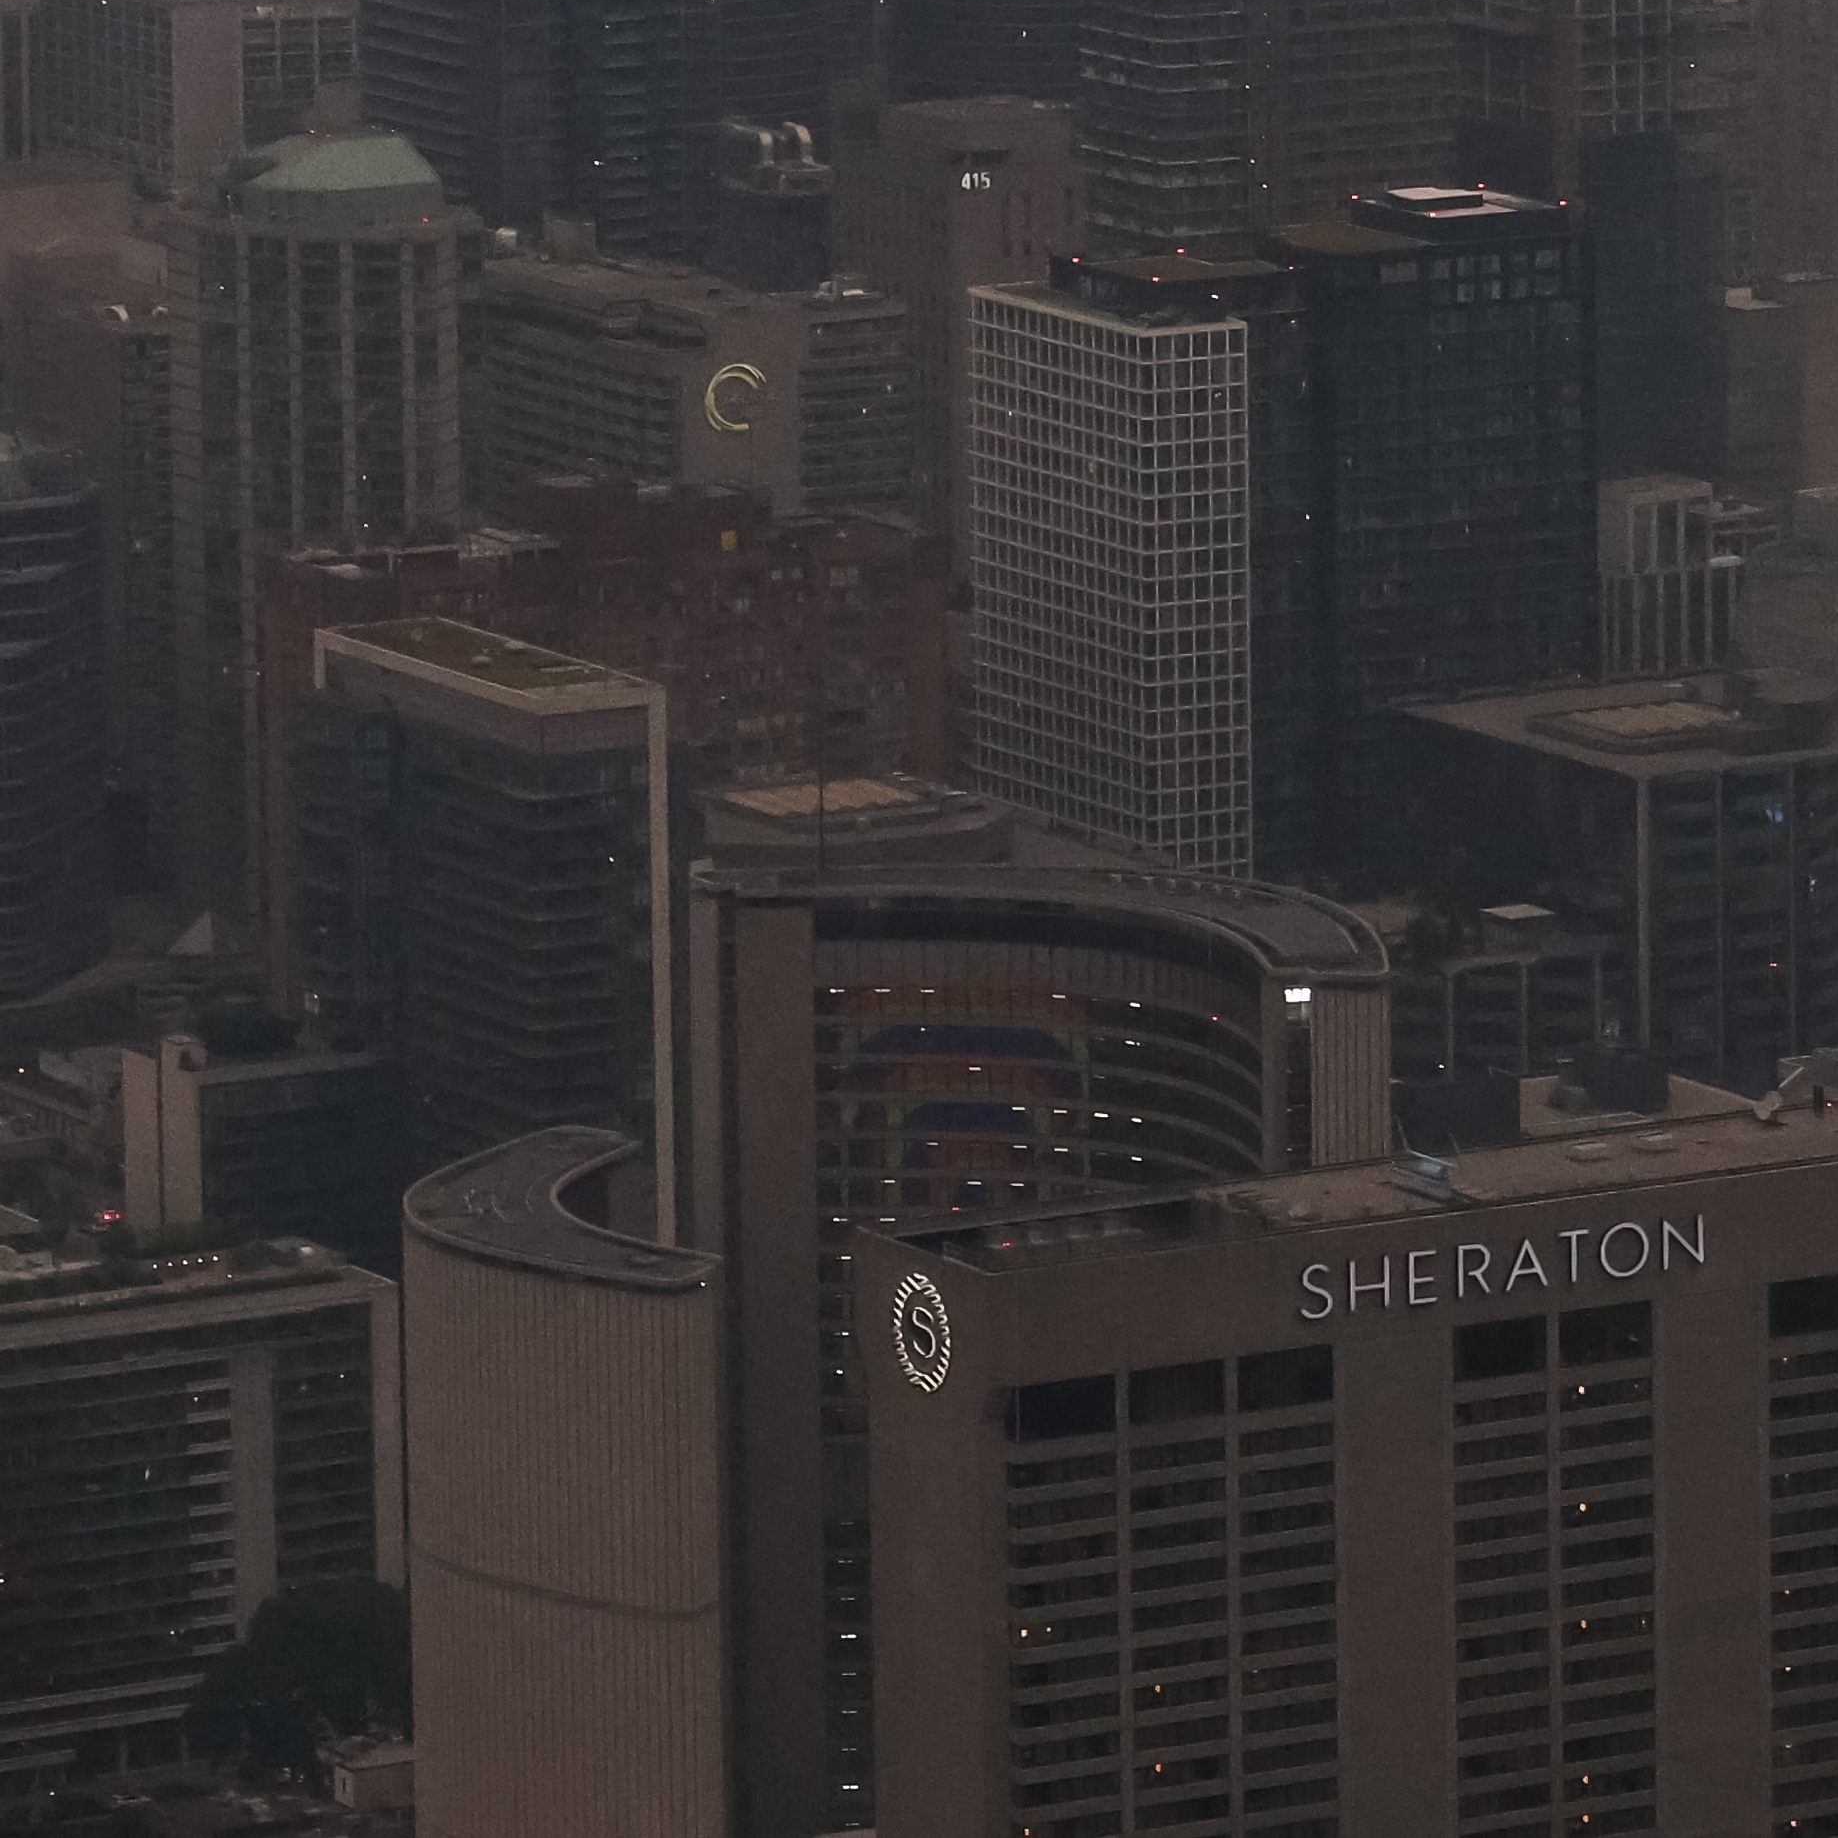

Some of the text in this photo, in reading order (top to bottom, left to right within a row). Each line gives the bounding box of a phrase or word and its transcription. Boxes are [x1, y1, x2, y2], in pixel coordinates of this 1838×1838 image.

[961, 172, 992, 190] 415
[1299, 1213, 1706, 1321] SHERATON
[911, 1306, 937, 1359] S
